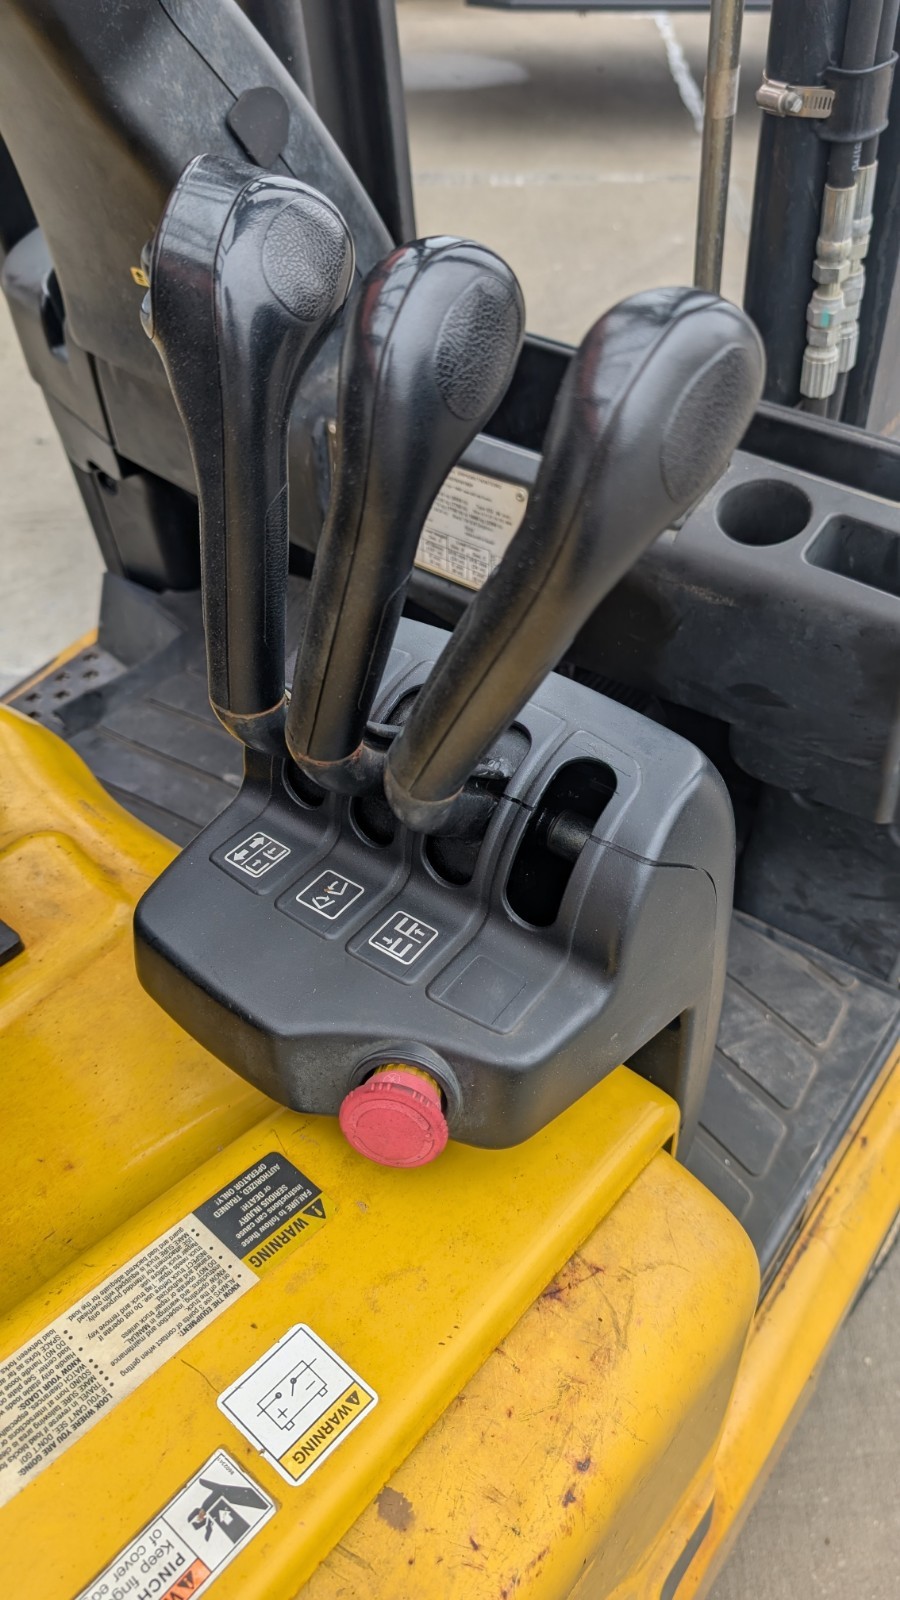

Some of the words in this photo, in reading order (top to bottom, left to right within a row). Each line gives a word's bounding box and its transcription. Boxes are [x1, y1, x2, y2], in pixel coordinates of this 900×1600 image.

[233, 1163, 266, 1190] OPERATOR
[239, 1163, 280, 1195] AUTHORIZED,
[215, 1188, 234, 1205] ONLY!
[241, 1191, 264, 1211] DEATH!
[260, 1184, 288, 1207] SERIOUS
[266, 1184, 303, 1213] instructions
[285, 1189, 312, 1211] FAILURE
[213, 1194, 242, 1217] TRAINED
[238, 1205, 262, 1226] INJURY
[254, 1212, 267, 1223] can
[259, 1215, 280, 1232] follow
[168, 1226, 184, 1241] guard
[235, 1221, 255, 1239] cause
[158, 1239, 169, 1249] and
[172, 1232, 189, 1246] MAKE
[182, 1236, 194, 1247] USE
[240, 1231, 260, 1247] these
[248, 1217, 308, 1267] WARNING
[146, 1247, 159, 1258] load
[158, 1244, 174, 1257] SURE
[181, 1241, 198, 1255] Repair
[188, 1245, 203, 1257] truck
[144, 1255, 160, 1267] truck
[153, 1245, 182, 1269] attachment
[167, 1254, 182, 1266] truck
[172, 1256, 189, 1270] needs
[185, 1250, 207, 1269] INSPECT
[193, 1254, 212, 1271] trained
[207, 1259, 217, 1268] DO
[124, 1256, 148, 1276] backrest
[146, 1267, 154, 1275] for
[150, 1265, 168, 1279] before
[170, 1267, 186, 1279] truck
[182, 1268, 194, 1279] and
[196, 1266, 208, 1277] NOT
[114, 1270, 139, 1292] equipped
[139, 1278, 151, 1288] use.
[157, 1268, 173, 1283] repair.
[175, 1275, 196, 1292] operate
[190, 1263, 221, 1289] instructions,
[209, 1268, 226, 1283] KNOW
[99, 1274, 125, 1295] adequate
[122, 1274, 146, 1294] intended
[144, 1283, 157, 1292] Tag
[154, 1278, 172, 1294] before
[155, 1277, 183, 1301] authorized.
[182, 1280, 209, 1303] operating,
[208, 1284, 217, 1293] off
[213, 1278, 235, 1297] ALWAYS
[222, 1282, 240, 1298] KNOW
[91, 1294, 100, 1302] for
[100, 1291, 122, 1311] purpose
[102, 1290, 115, 1301] with
[130, 1291, 146, 1304] truck
[142, 1292, 154, 1302] use.
[179, 1288, 190, 1299] and
[199, 1290, 210, 1299] the
[203, 1295, 213, 1305] use
[80, 1301, 91, 1310] the
[119, 1303, 131, 1314] and
[133, 1302, 143, 1310] Do
[154, 1297, 170, 1312] repair
[155, 1297, 180, 1319] warnings
[184, 1298, 201, 1311] truck.
[211, 1297, 224, 1308] THE
[66, 1309, 82, 1321] load.
[76, 1300, 102, 1323] overhead
[85, 1310, 100, 1322] only.
[123, 1309, 134, 1319] not
[139, 1310, 155, 1323] truck
[156, 1303, 184, 1327] inspection
[182, 1307, 199, 1323] points
[98, 1312, 120, 1330] remove
[102, 1317, 124, 1336] operate
[178, 1306, 212, 1336] EQUIPMENT:
[41, 1328, 56, 1341] load
[86, 1329, 99, 1340] key.
[120, 1322, 139, 1338] unless
[125, 1323, 150, 1344] MANUAL.
[145, 1325, 157, 1337] and
[155, 1327, 176, 1346] contact
[16, 1339, 43, 1361] between
[40, 1334, 61, 1352] SPACE
[55, 1340, 66, 1350] DO
[110, 1335, 146, 1366] maintenance
[24, 1350, 41, 1364] forks
[42, 1348, 56, 1361] NOT
[56, 1345, 71, 1358] load
[140, 1344, 156, 1359] when
[15, 1363, 24, 1371] as
[20, 1359, 42, 1377] handle
[37, 1356, 57, 1374] center.
[54, 1351, 76, 1369] Handle
[61, 1357, 81, 1375] KNOW
[119, 1357, 141, 1376] getting
[6, 1370, 16, 1379] far
[23, 1374, 36, 1385] See
[41, 1368, 54, 1381] only
[63, 1363, 86, 1383] WATCH
[69, 1369, 91, 1389] SOUND
[3, 1376, 21, 1391] loose
[22, 1379, 41, 1396] stable
[42, 1374, 61, 1390] YOUR
[78, 1375, 96, 1392] MAKE
[7, 1383, 23, 1398] plate
[28, 1381, 63, 1410] clearances,
[60, 1390, 79, 1406] SURE
[78, 1381, 102, 1401] TRAVEL
[100, 1386, 107, 1395] IF
[4, 1395, 23, 1410] loads
[17, 1389, 43, 1410] LOADS:
[46, 1399, 54, 1407] at
[70, 1400, 79, 1408] in
[86, 1393, 101, 1406] YOU
[93, 1393, 112, 1410] LOOK
[32, 1404, 61, 1429] tailswing
[48, 1406, 71, 1427] reverse
[68, 1404, 87, 1423] CAN'T
[70, 1408, 95, 1430] WHERE
[7, 1406, 47, 1440] intersections
[51, 1420, 68, 1434] SEE,
[18, 1427, 33, 1441] area
[28, 1430, 43, 1445] load
[56, 1429, 72, 1443] YOU
[292, 1404, 352, 1464] WARNING
[11, 1440, 19, 1448] is
[32, 1433, 53, 1453] DON'T
[41, 1440, 56, 1456] ARE
[7, 1443, 29, 1462] blocks
[19, 1451, 32, 1464] GO!
[18, 1454, 42, 1475] GOING:
[149, 1529, 162, 1546] of
[113, 1545, 146, 1582] cover
[140, 1540, 174, 1574] Keep
[138, 1552, 186, 1600] PINCH
